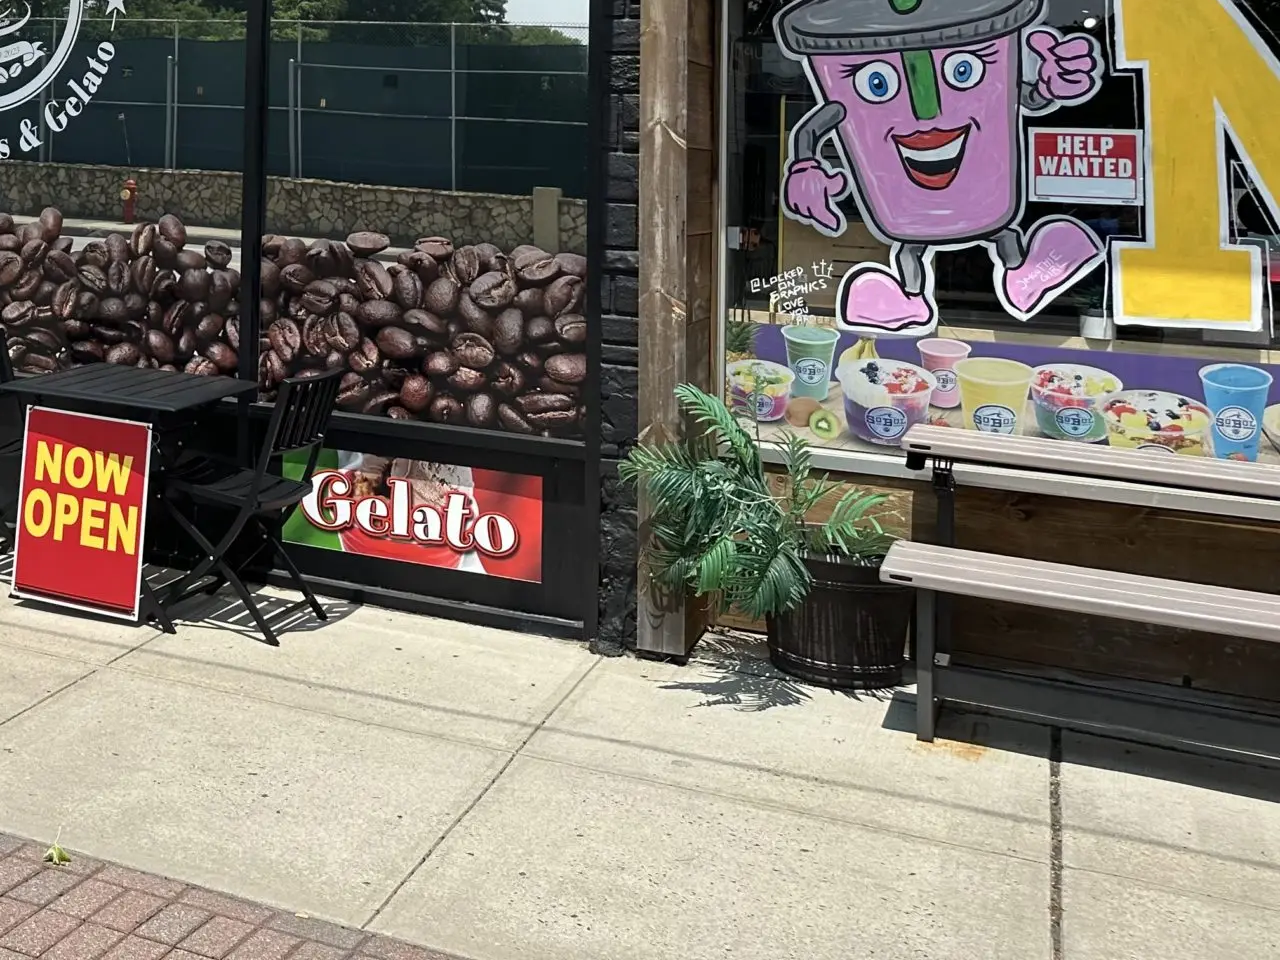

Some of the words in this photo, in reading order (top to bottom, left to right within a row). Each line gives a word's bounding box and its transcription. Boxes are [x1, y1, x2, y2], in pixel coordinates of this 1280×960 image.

[19, 118, 43, 152] &
[44, 41, 116, 133] Gelato
[1038, 156, 1133, 178] WANTED
[1057, 135, 1114, 156] HELP
[35, 440, 134, 494] NOW
[23, 488, 138, 556] OPEN
[302, 469, 520, 558] Gelato
